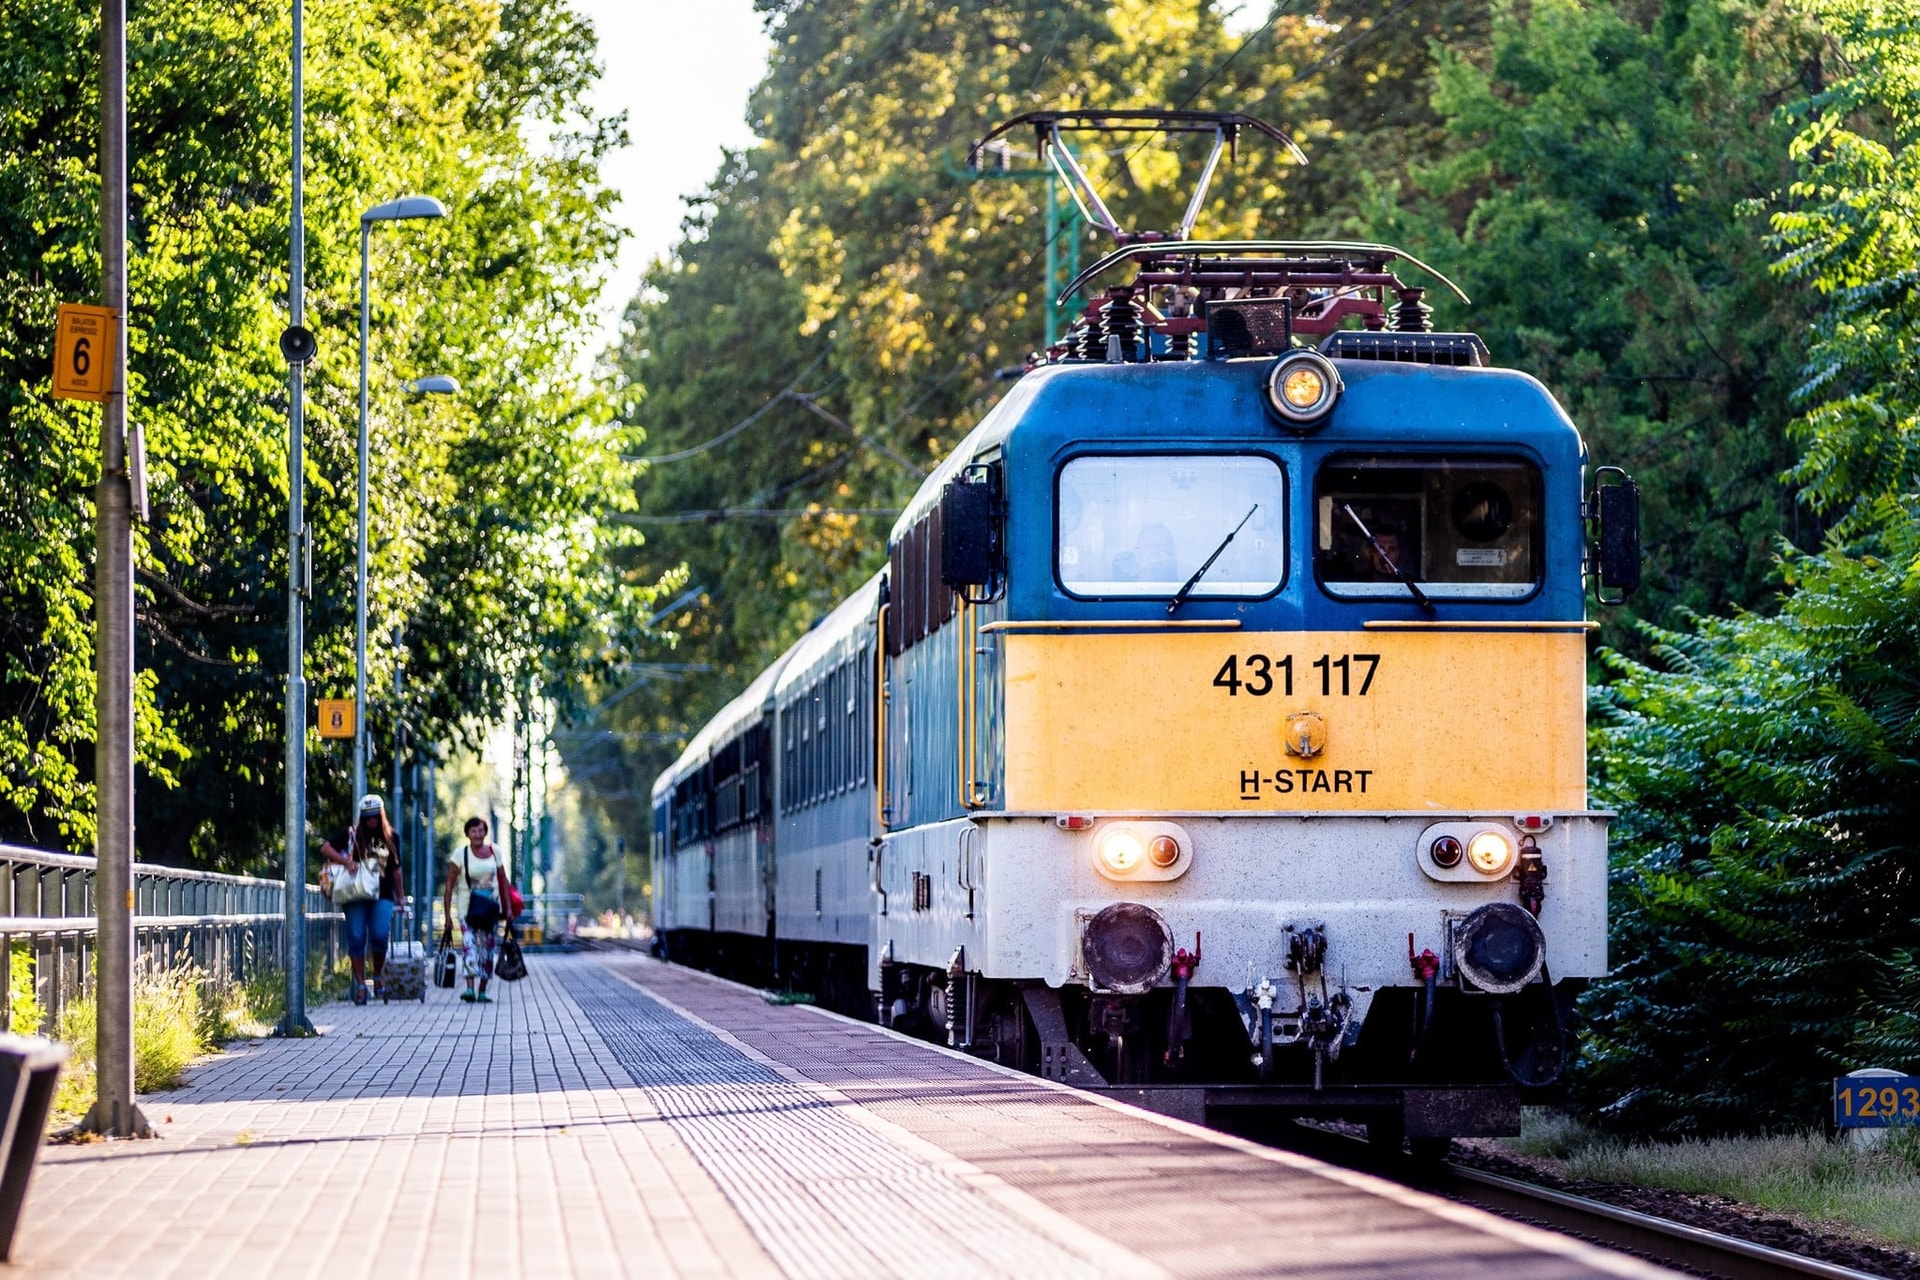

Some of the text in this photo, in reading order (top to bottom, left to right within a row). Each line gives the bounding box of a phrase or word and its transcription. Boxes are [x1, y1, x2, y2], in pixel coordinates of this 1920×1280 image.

[73, 337, 91, 376] 6
[1213, 654, 1381, 696] 431 117
[331, 711, 343, 729] 8
[1240, 769, 1373, 796] H-START
[1838, 1087, 1920, 1117] 1293
